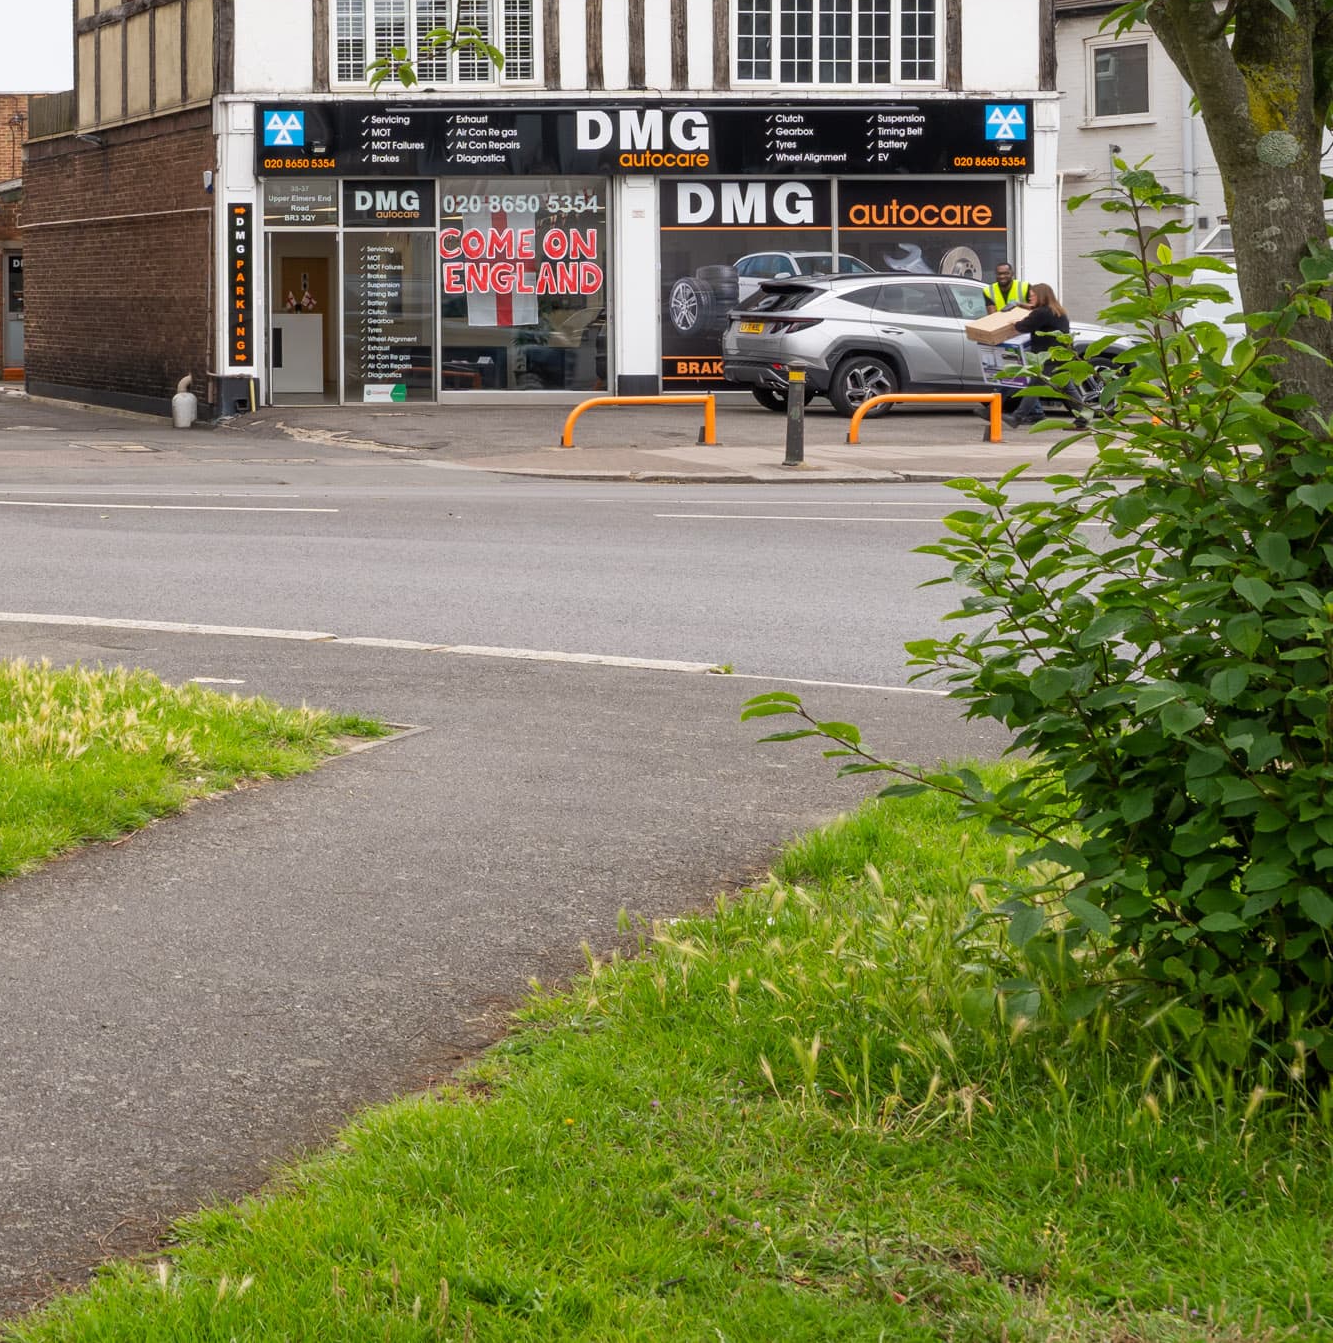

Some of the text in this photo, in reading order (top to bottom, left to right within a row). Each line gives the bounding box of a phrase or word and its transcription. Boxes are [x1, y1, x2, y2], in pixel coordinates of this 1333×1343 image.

[371, 116, 410, 125] Servicing
[456, 115, 488, 124] Exhaust
[775, 114, 804, 123] Clutch
[877, 114, 925, 124] Suspension
[456, 128, 518, 138] Air Con Re gas
[576, 110, 710, 150] DMG
[775, 128, 814, 136] Gearbox
[877, 127, 923, 137] Timing Belt
[392, 141, 424, 150] Failures
[456, 141, 520, 151] Air Con Repairs
[775, 140, 796, 150] Tyres
[878, 140, 908, 150] Battery
[371, 155, 399, 163] Brakes
[456, 154, 506, 164] Diagnostics
[619, 151, 709, 168] autocare
[775, 153, 847, 163] Wheel Alignment
[954, 157, 1026, 167] 020 8650 5354
[264, 159, 336, 169] 020 8650 5354
[268, 195, 290, 204] Upper
[354, 190, 420, 211] DMG
[443, 194, 598, 213] 020 8650 5354
[677, 181, 814, 225] DMG
[376, 210, 420, 219] autocare
[849, 199, 993, 225] autocare
[235, 217, 246, 254] DMG
[439, 227, 597, 260] COME ON
[443, 262, 604, 295] ENGLAND
[236, 260, 246, 351] PARKING
[676, 361, 725, 374] BRAK
